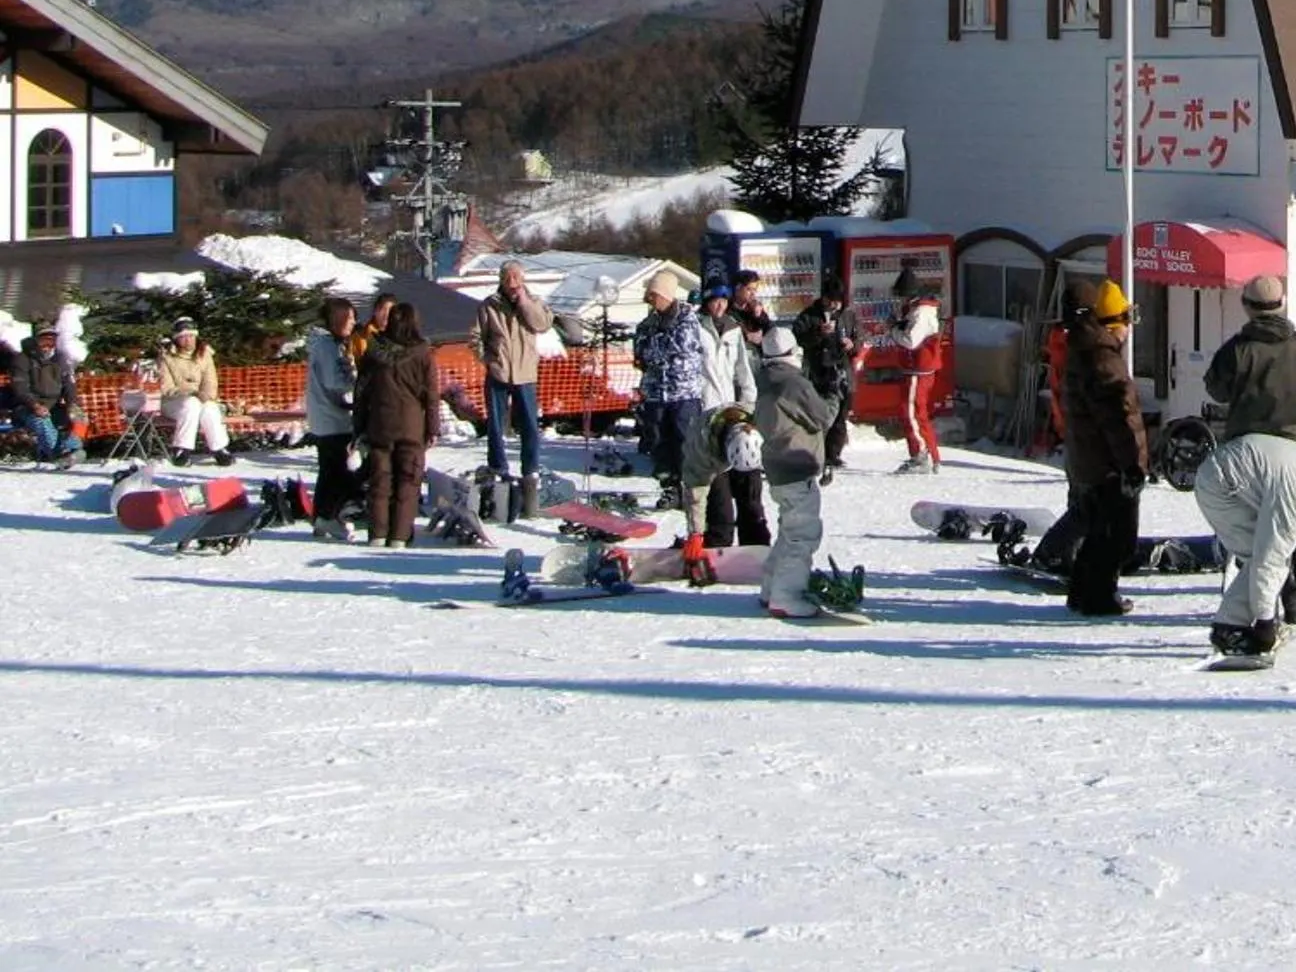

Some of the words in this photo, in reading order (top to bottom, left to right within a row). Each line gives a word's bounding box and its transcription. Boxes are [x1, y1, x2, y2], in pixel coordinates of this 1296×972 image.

[1161, 249, 1191, 261] VALLEY
[1133, 259, 1158, 271] PORTS
[1166, 261, 1196, 273] SCHOOL
